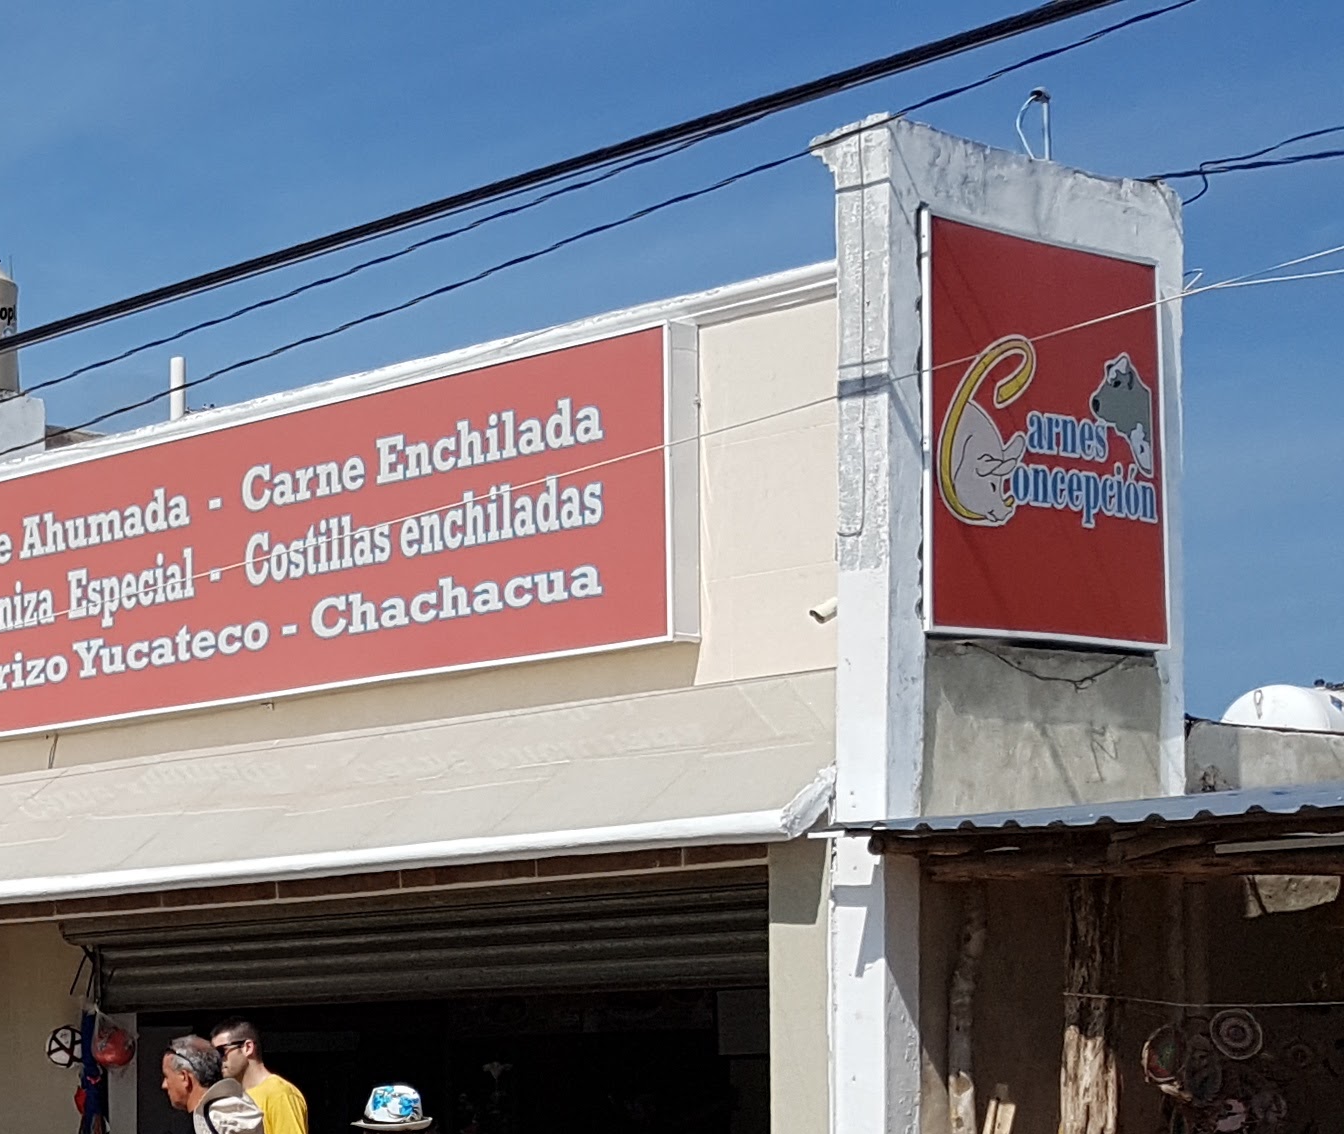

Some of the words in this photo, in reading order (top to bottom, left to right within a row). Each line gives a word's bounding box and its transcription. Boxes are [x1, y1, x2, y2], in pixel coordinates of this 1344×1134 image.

[19, 487, 190, 560] Ahumada
[241, 454, 365, 512] Carne
[375, 397, 603, 486] Enchilada
[67, 547, 195, 628] Especial
[244, 514, 391, 587] Costillas
[400, 475, 603, 558] enchiladas
[72, 619, 269, 679] Yucateco
[311, 563, 602, 639] Chachacua
